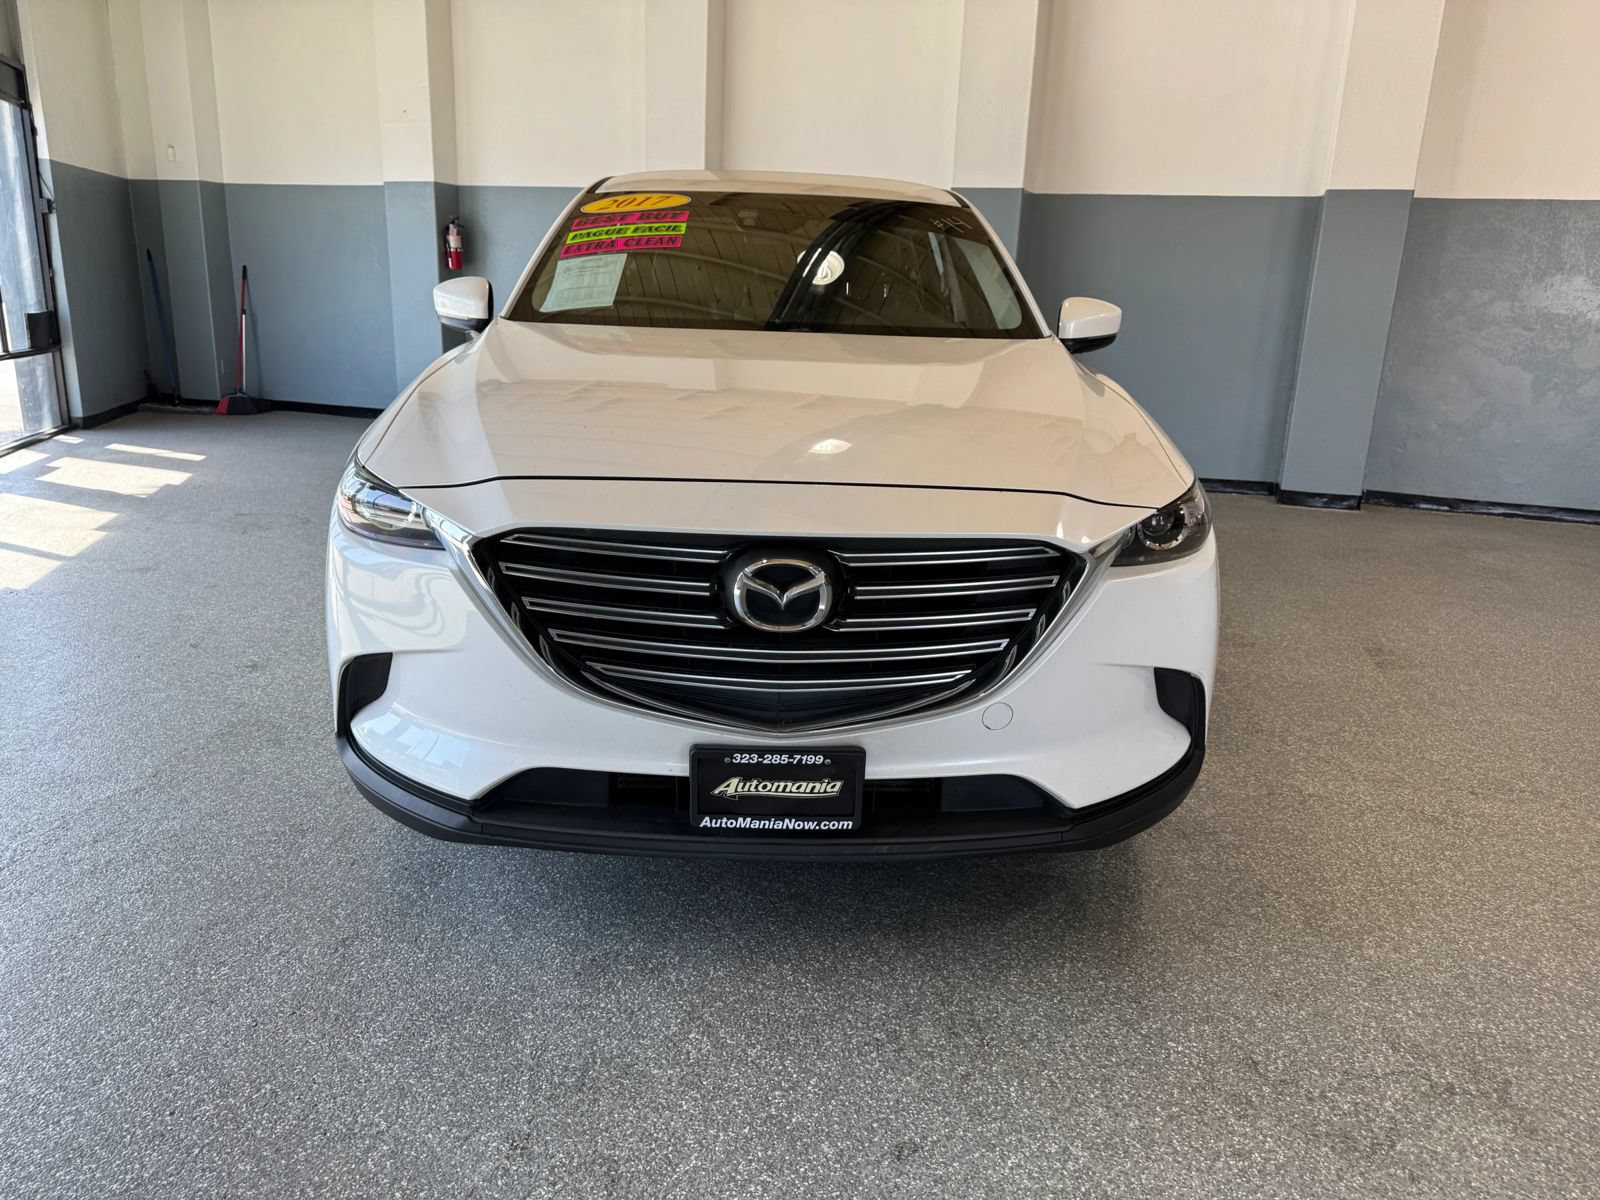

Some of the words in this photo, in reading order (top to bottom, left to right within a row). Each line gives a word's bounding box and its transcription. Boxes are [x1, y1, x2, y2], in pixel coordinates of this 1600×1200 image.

[597, 195, 674, 211] 2017
[575, 213, 632, 226] BEST
[636, 212, 685, 221] BUY
[571, 226, 630, 241] PAGUE
[564, 240, 618, 254] EXTRA
[623, 236, 678, 248] CLEAN
[732, 753, 824, 765] 323-285-7199
[711, 777, 844, 797] Automania
[699, 816, 854, 831] AutoManiaNow.com
